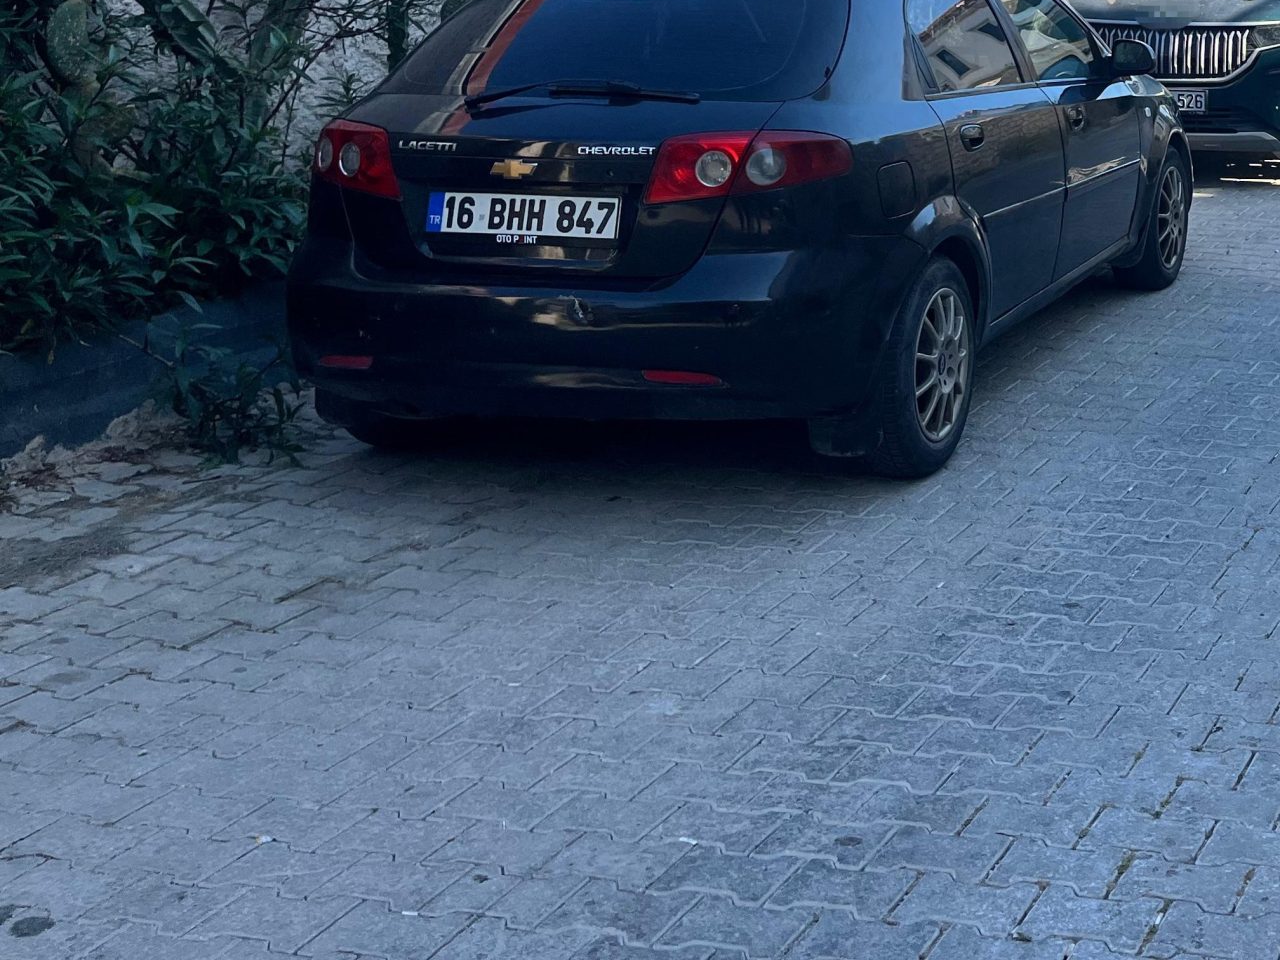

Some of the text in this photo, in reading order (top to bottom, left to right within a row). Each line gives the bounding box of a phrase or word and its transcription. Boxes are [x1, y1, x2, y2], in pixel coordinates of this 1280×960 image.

[1177, 93, 1203, 109] 526
[398, 139, 457, 152] LACETTI
[577, 145, 657, 156] CHEVROLET
[429, 214, 441, 225] TR
[445, 196, 616, 234] 16 BHH 847
[496, 234, 512, 243] OTO
